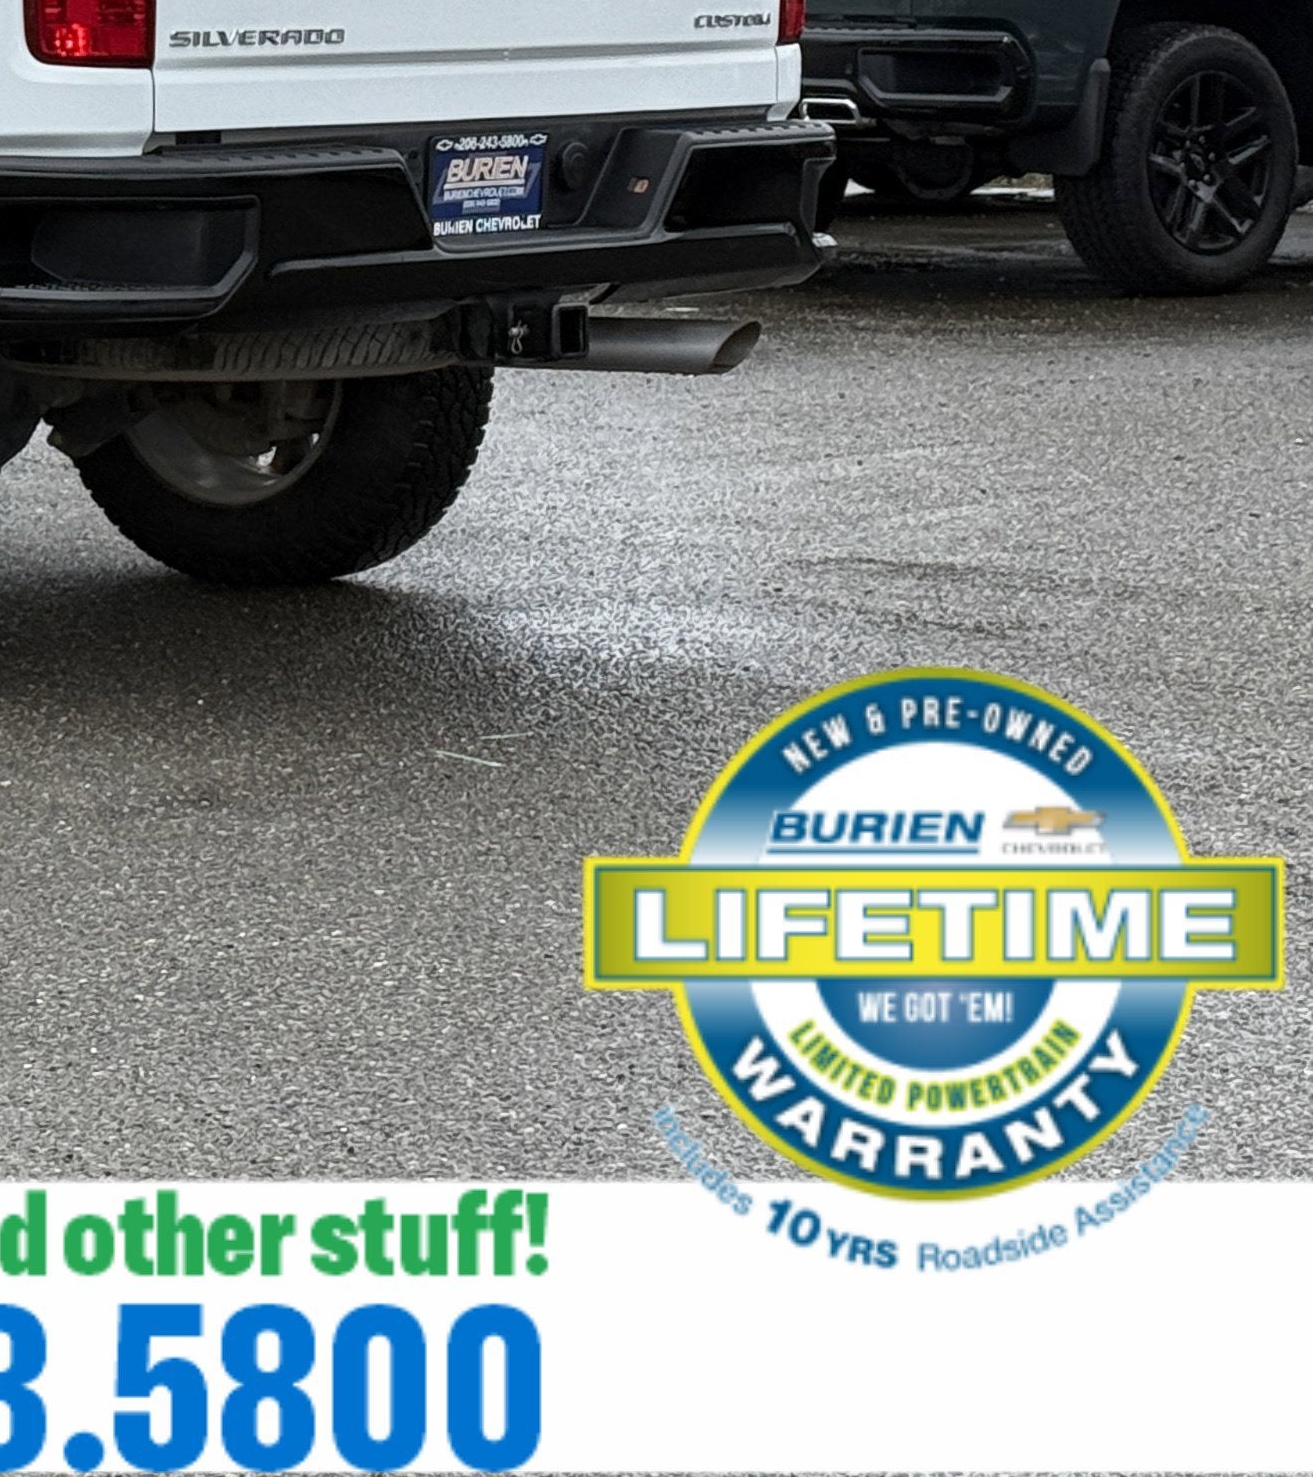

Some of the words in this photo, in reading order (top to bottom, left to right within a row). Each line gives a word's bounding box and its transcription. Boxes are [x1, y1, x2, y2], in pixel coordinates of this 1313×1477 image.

[168, 28, 346, 49] SILVERADO
[446, 155, 530, 183] BURIEN
[433, 217, 474, 237] BURIEN
[475, 213, 542, 233] CHEVROLET
